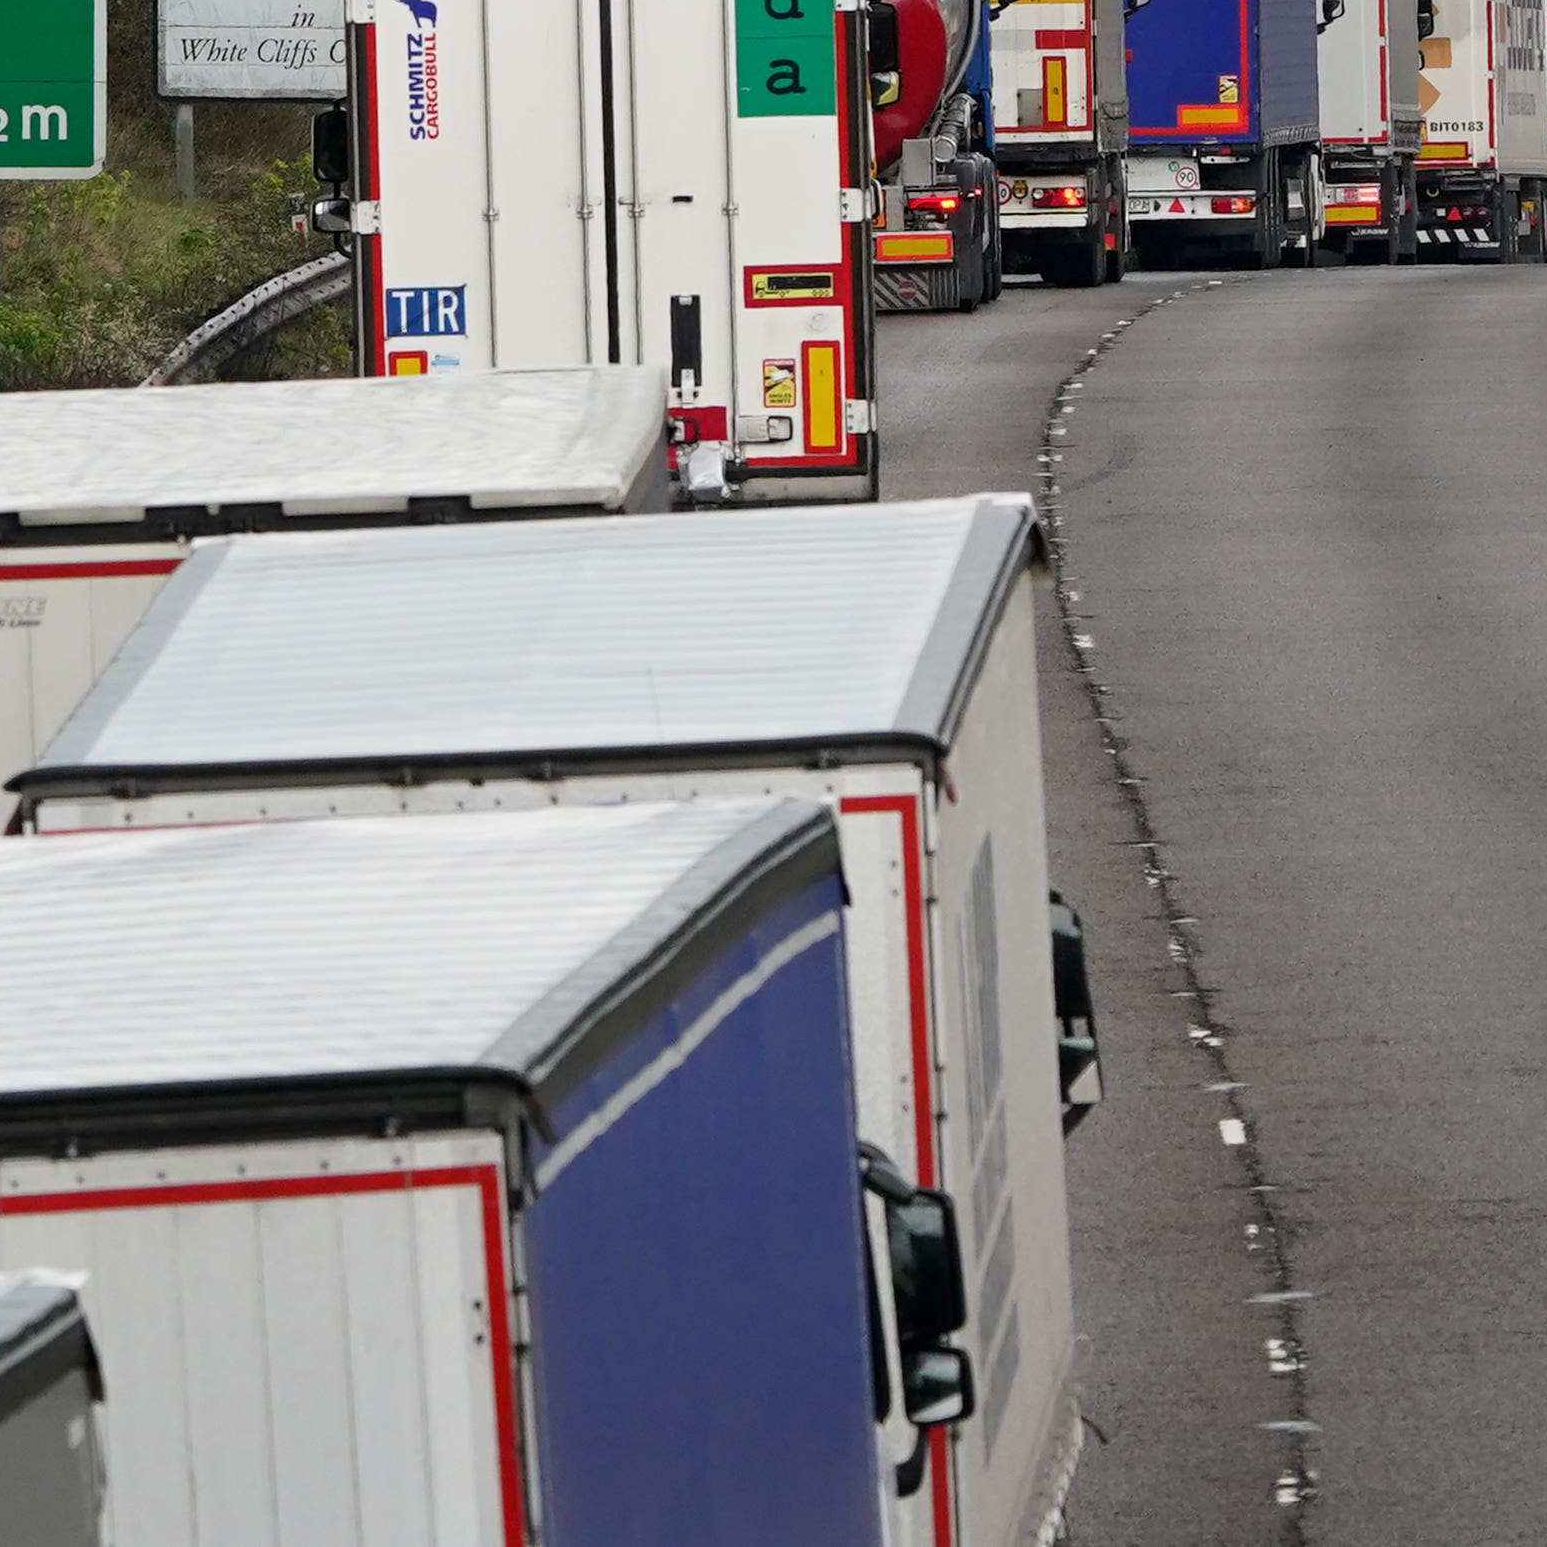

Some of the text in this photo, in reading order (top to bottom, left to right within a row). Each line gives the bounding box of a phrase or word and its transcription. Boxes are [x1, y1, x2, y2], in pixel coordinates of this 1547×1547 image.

[291, 4, 315, 28] in
[180, 38, 247, 62] White
[257, 38, 318, 70] Cliffs
[407, 33, 426, 140] SCHMITZ
[424, 33, 439, 139] CARGOBULL
[766, 57, 807, 95] a
[1179, 170, 1195, 184] 90
[392, 291, 459, 333] TIR
